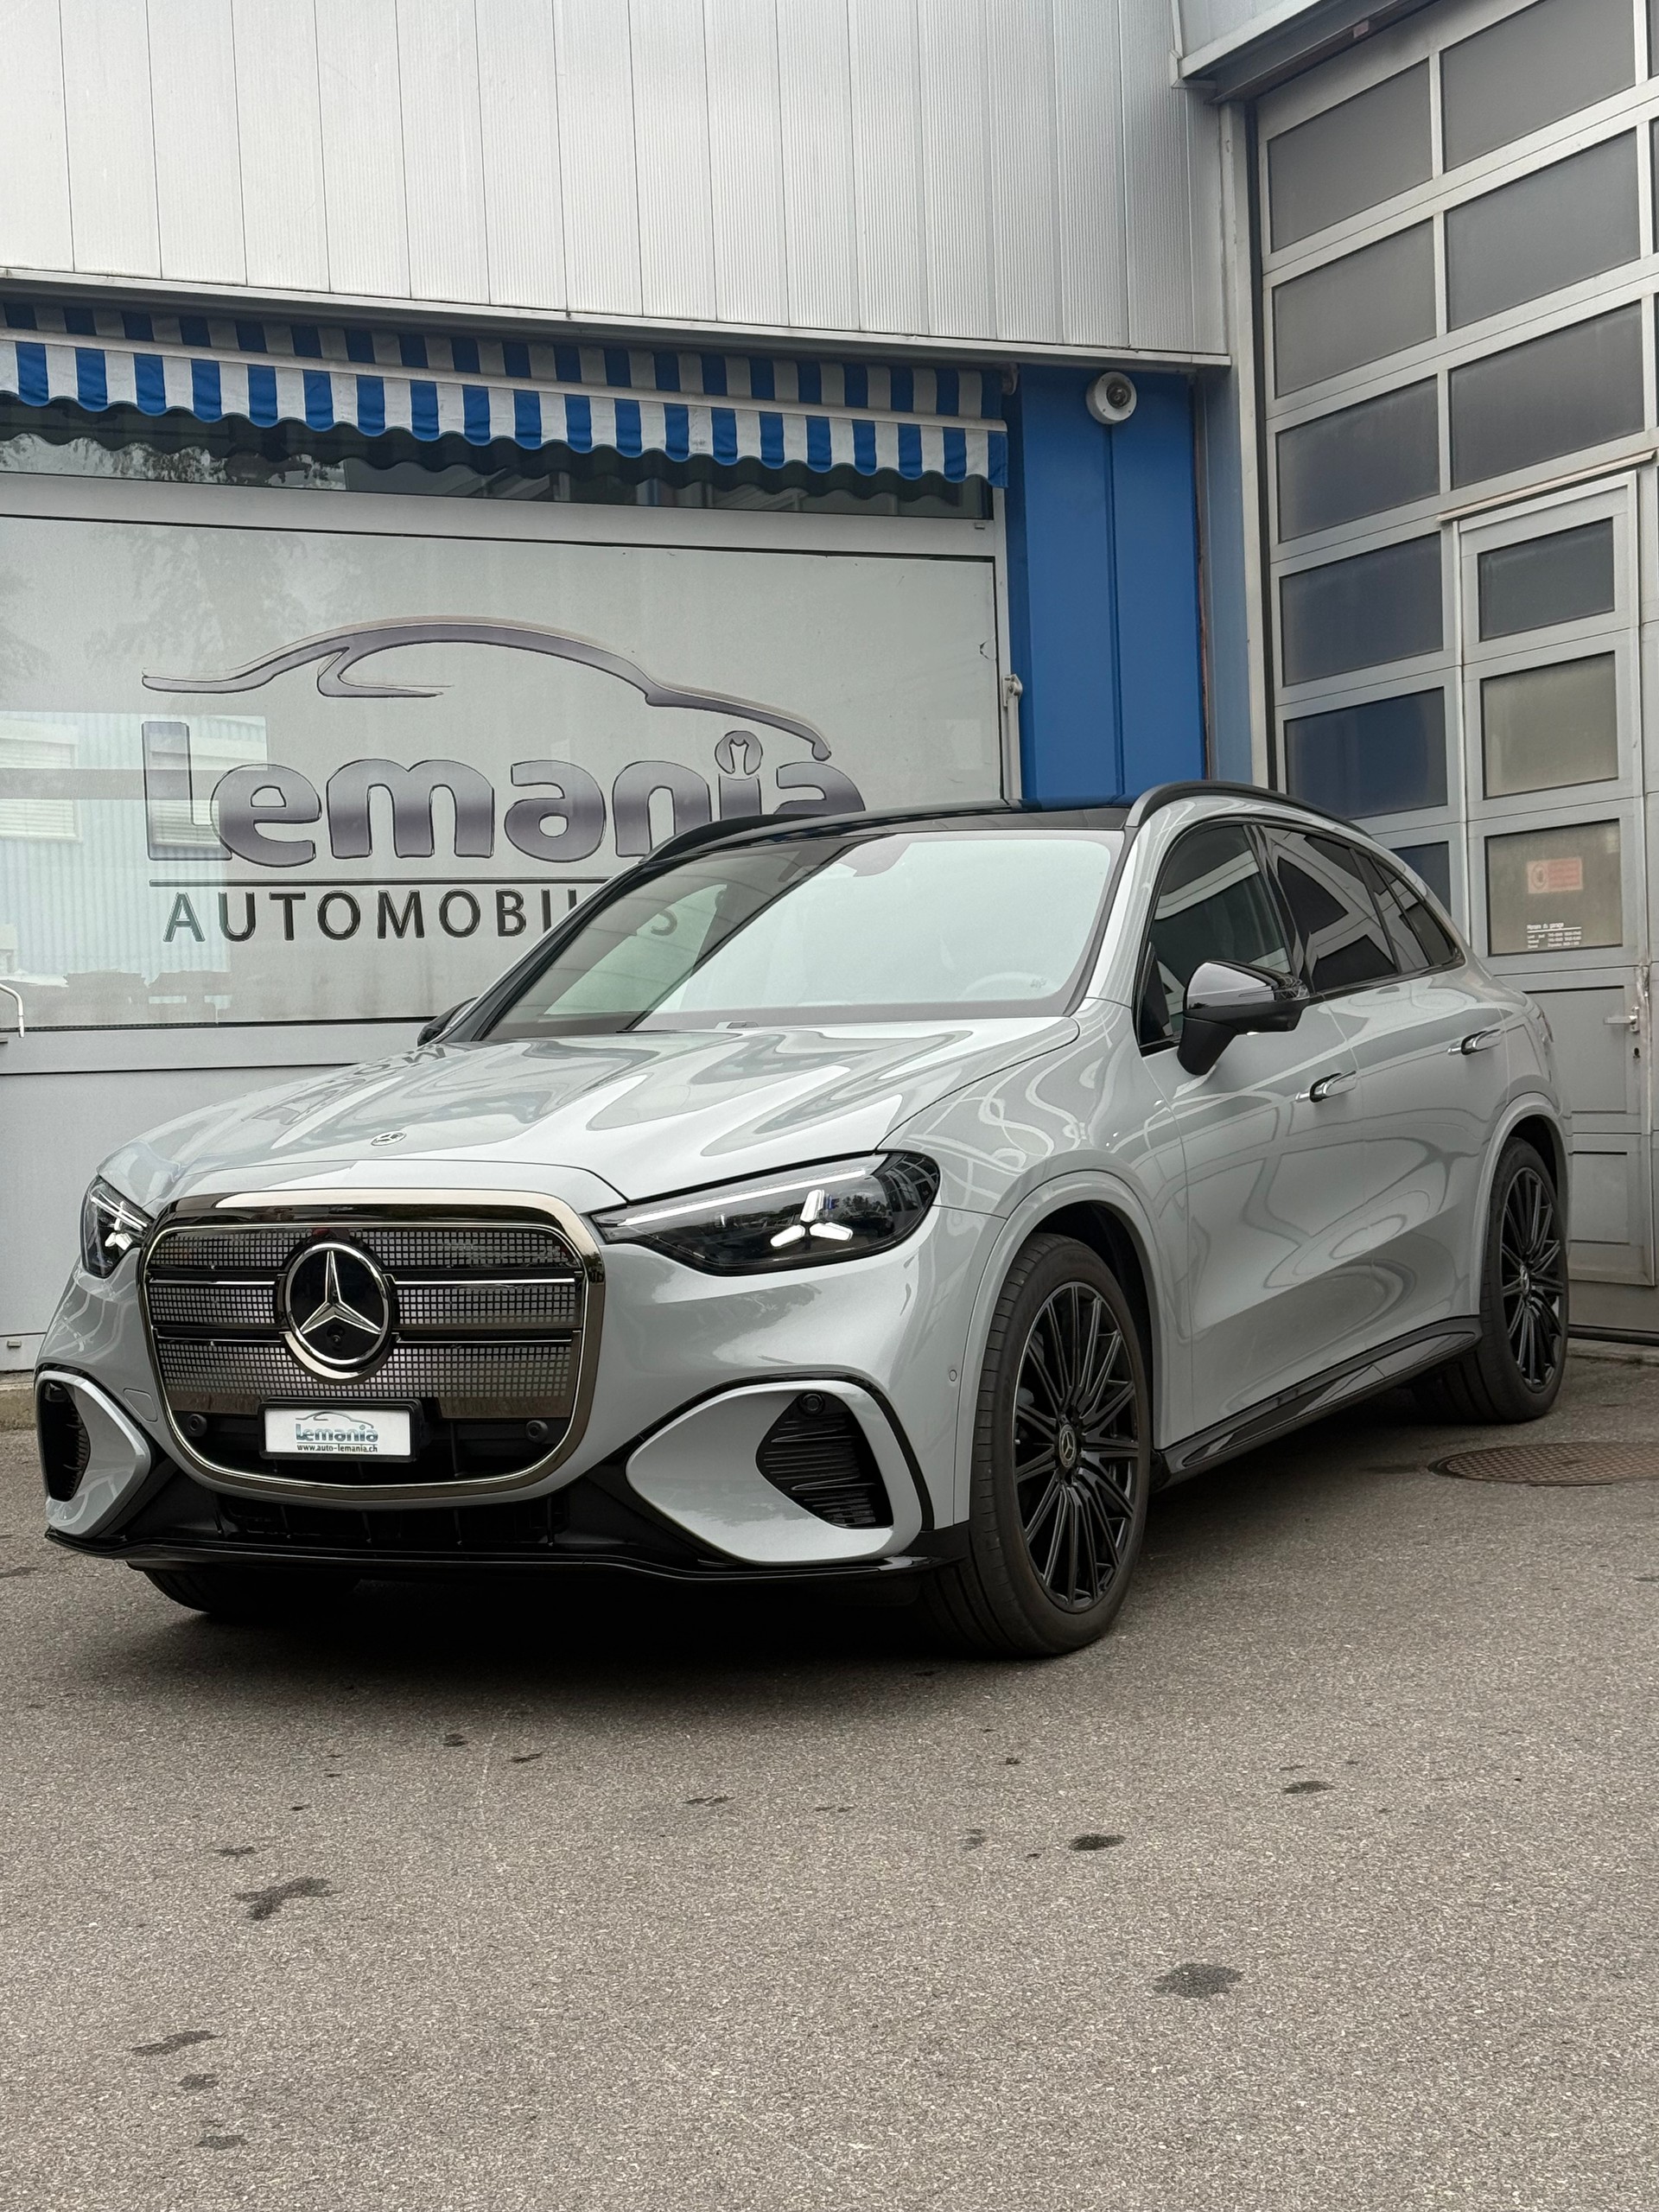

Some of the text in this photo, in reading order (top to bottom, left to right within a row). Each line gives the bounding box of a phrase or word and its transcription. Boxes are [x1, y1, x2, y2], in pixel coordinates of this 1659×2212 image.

[141, 721, 866, 868] Lemania
[296, 1423, 378, 1442] Lemania
[296, 1444, 378, 1452] www.auto-lemania.ch
